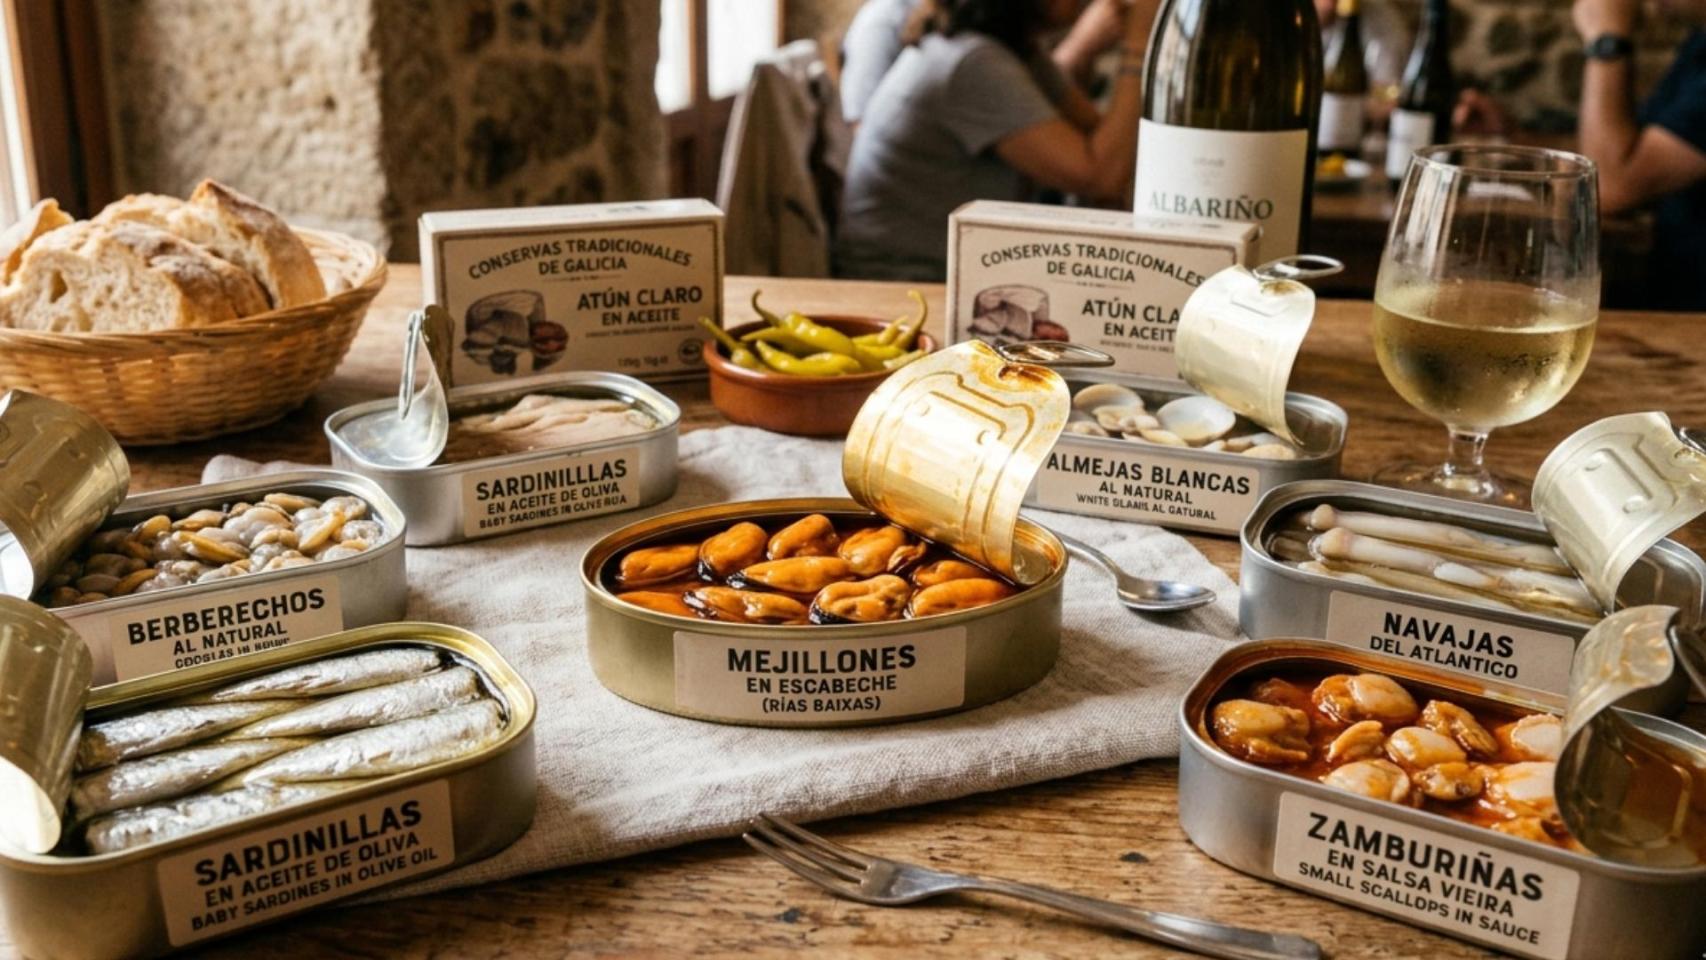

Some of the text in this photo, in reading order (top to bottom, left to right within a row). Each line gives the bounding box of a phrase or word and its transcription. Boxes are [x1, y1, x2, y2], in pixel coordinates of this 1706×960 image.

[1149, 191, 1274, 220] ALBARIÑO
[469, 238, 691, 279] CONSERVAS TRADICIONALES
[538, 257, 627, 275] DE GALICIA
[981, 243, 1071, 268] CONSERVAS
[1047, 261, 1136, 282] DE GALICIA
[577, 286, 702, 310] ATÚN CLARO
[1081, 297, 1180, 325] ATÚN CLA
[602, 308, 680, 326] EN ACEITE
[1104, 323, 1176, 343] EN ACEIT
[1046, 452, 1250, 495] ALMEJAS BLANCAS
[487, 482, 620, 515] EN ACEITE DE OLIVA
[1099, 481, 1193, 505] AL NATURAL
[127, 588, 325, 645] BERBERECHOS
[173, 640, 197, 656] AL
[203, 621, 287, 648] NATURAL
[1383, 612, 1514, 658] NAVAJAS
[727, 644, 916, 674] MEJILLONES
[1370, 635, 1518, 679] DEL ATLANTICO
[747, 675, 896, 693] EN ESCABECHE
[762, 695, 881, 713] (RÍAS BAIXAS)
[195, 800, 422, 886] SARDINILLAS
[1307, 812, 1544, 901] ZAMBURIÑAS
[205, 885, 233, 908] EN
[324, 850, 351, 873] DE
[358, 832, 419, 861] OLIVA
[1327, 849, 1514, 918] EN SALSA VIEIRA
[192, 847, 438, 931] BABY SARDINES IN OLIVE OIL
[1298, 862, 1354, 890] SMALL
[1455, 908, 1473, 925] IN
[1479, 915, 1541, 945] SAUCE
